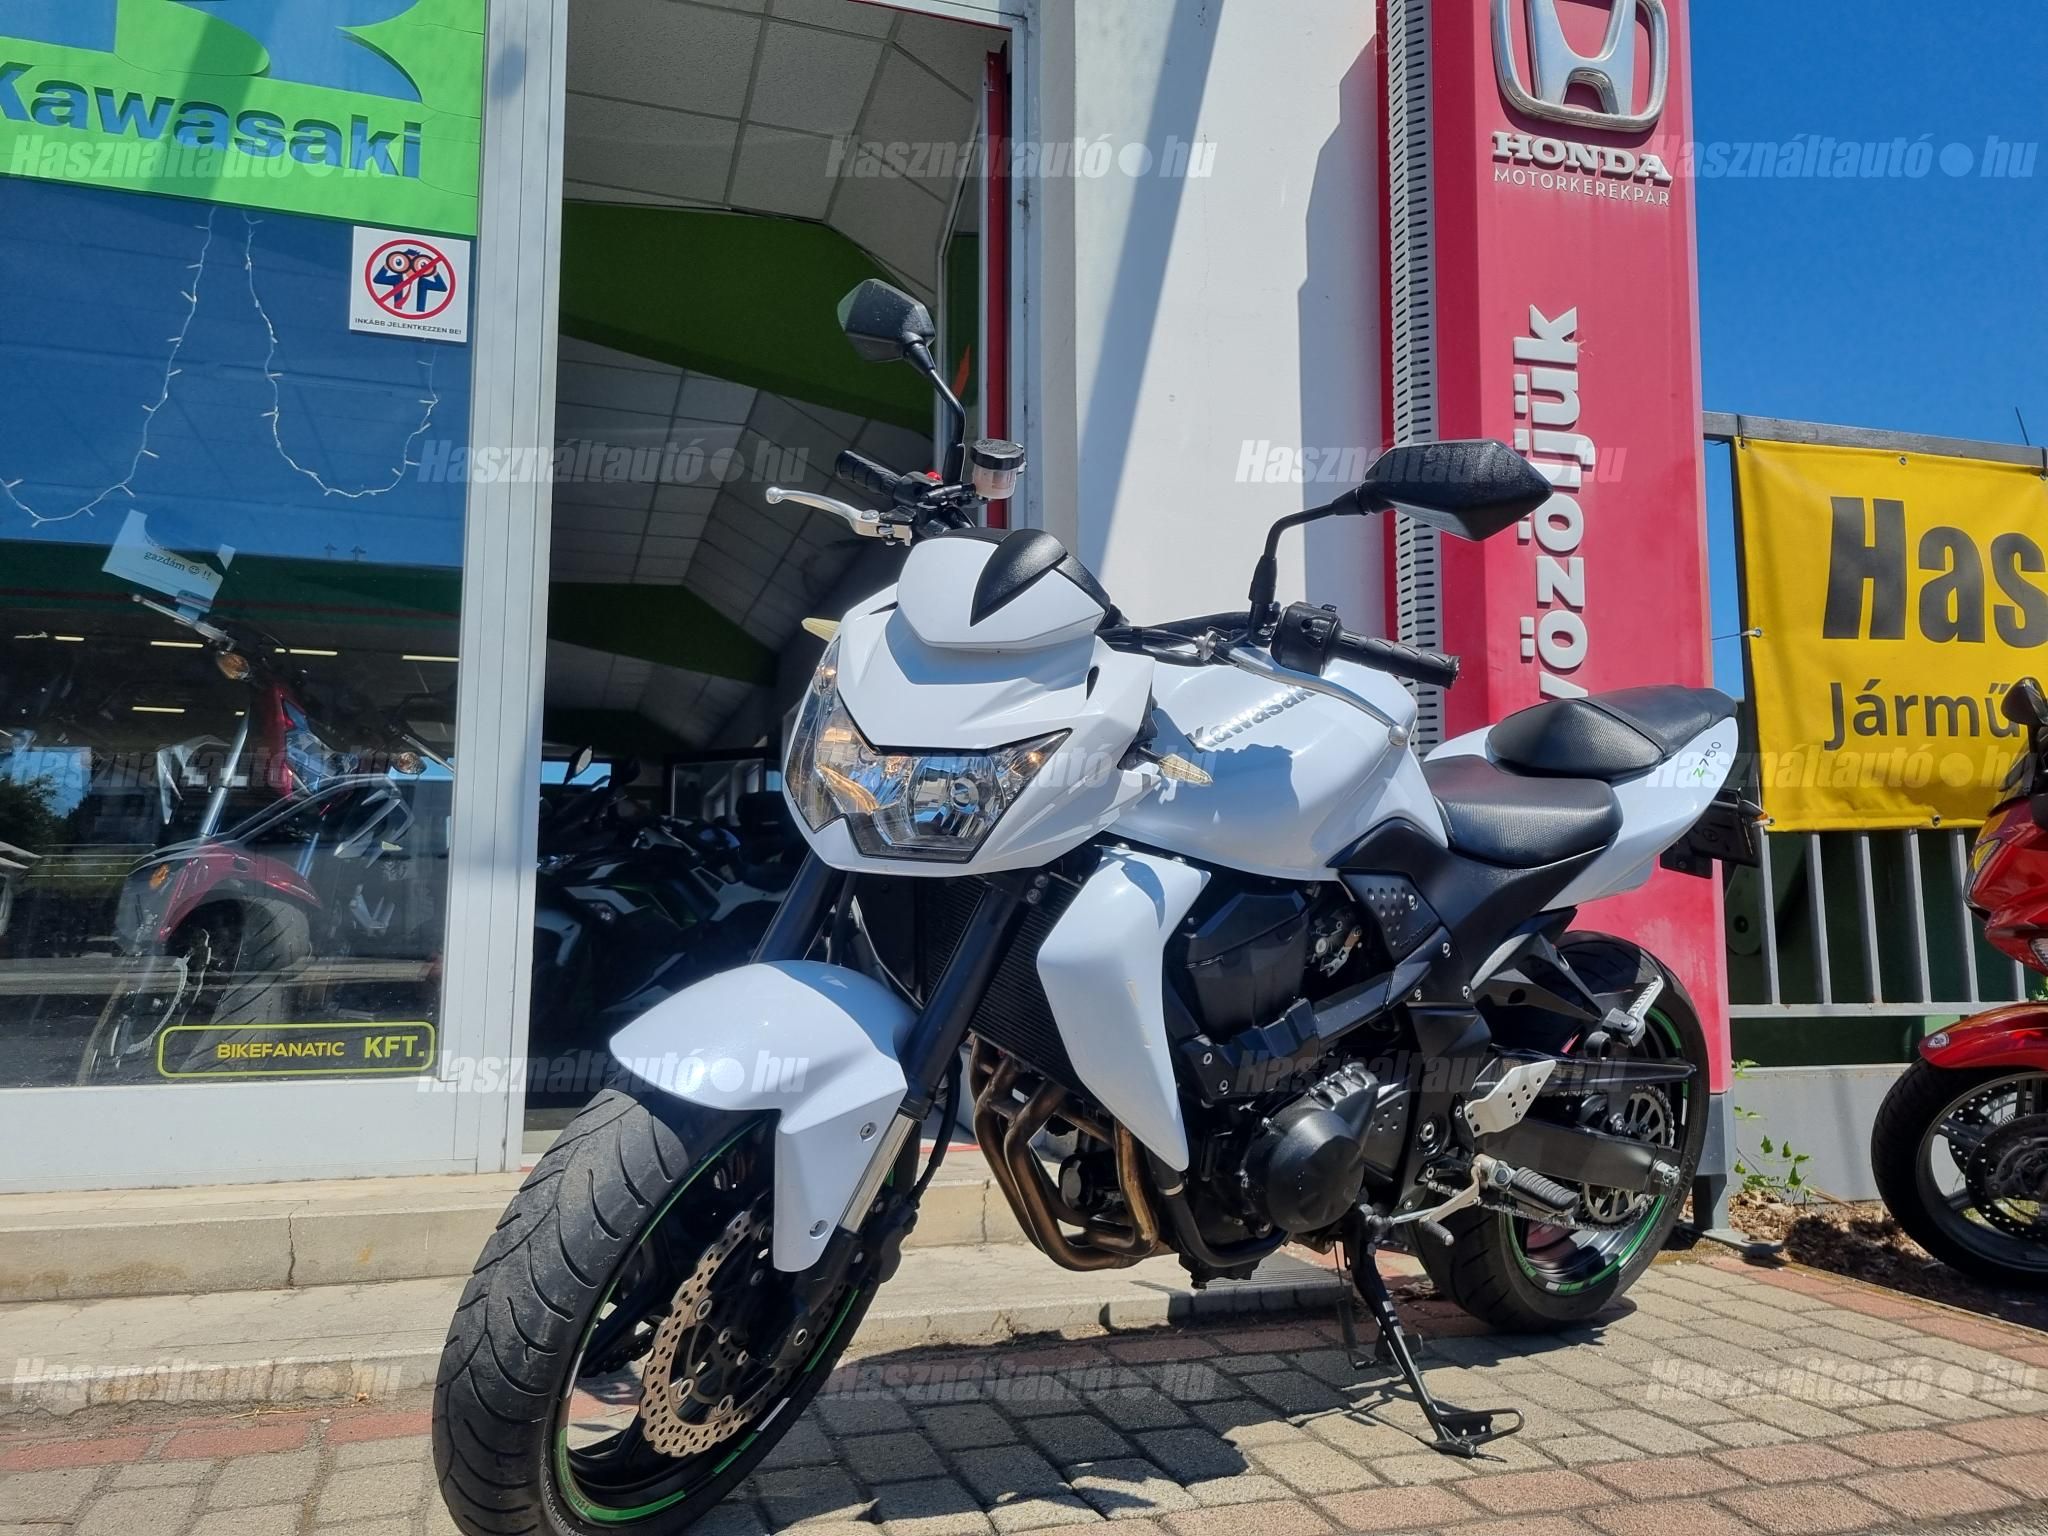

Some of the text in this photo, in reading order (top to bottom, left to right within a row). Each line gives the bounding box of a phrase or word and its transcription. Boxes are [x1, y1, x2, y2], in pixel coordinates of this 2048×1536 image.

[0, 62, 422, 179] Kawasaki
[1492, 131, 1672, 184] HONDA
[1493, 167, 1671, 206] MOTORKERÉKPÁR
[355, 317, 386, 327] INKÁBB
[387, 320, 448, 334] JELENTKEZZEN
[144, 551, 185, 571] gazdám
[1822, 496, 2048, 648] Has
[1692, 741, 1722, 778] Z750
[216, 1035, 425, 1060] BIKEFANATIC KFT.
